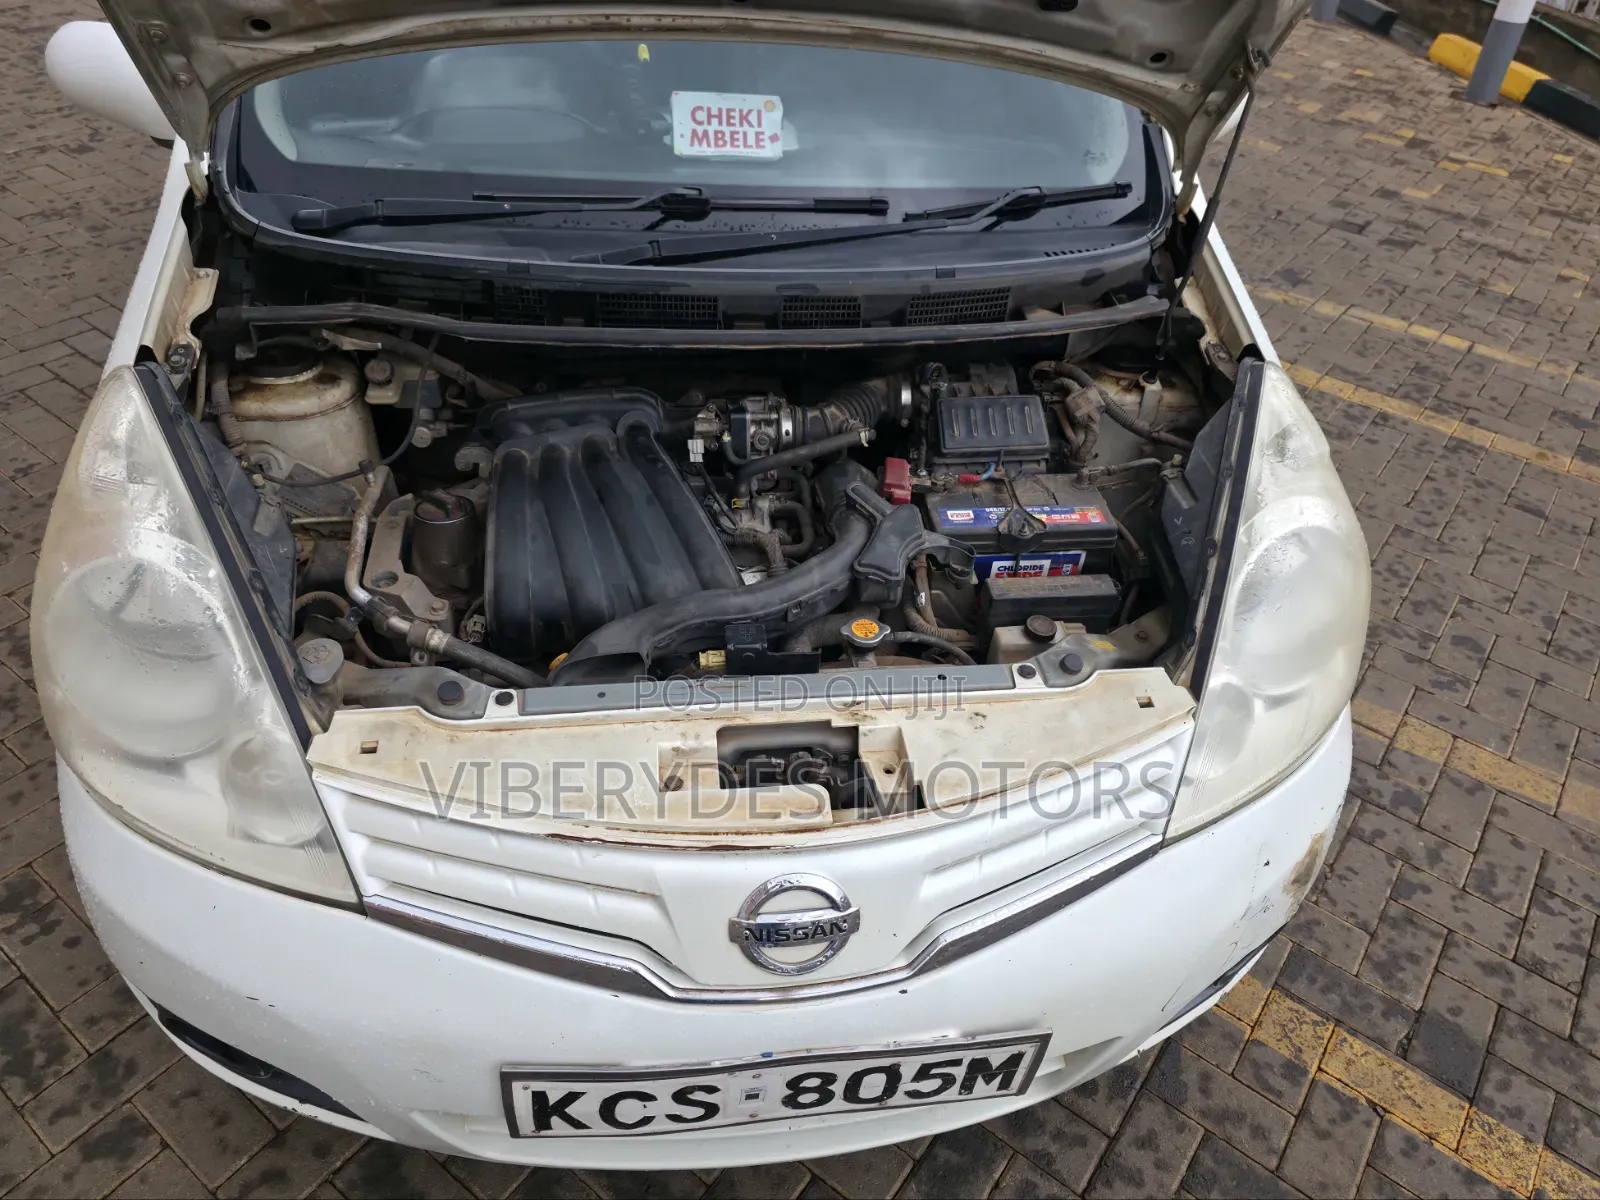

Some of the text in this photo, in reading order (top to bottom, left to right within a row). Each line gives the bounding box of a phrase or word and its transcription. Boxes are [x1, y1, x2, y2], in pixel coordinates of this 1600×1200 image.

[690, 105, 763, 128] CHEKI
[689, 128, 766, 150] MBELE
[997, 564, 1045, 572] CHLORIDE
[744, 920, 848, 943] NISSAN
[530, 1051, 1026, 1132] KCS 805M
